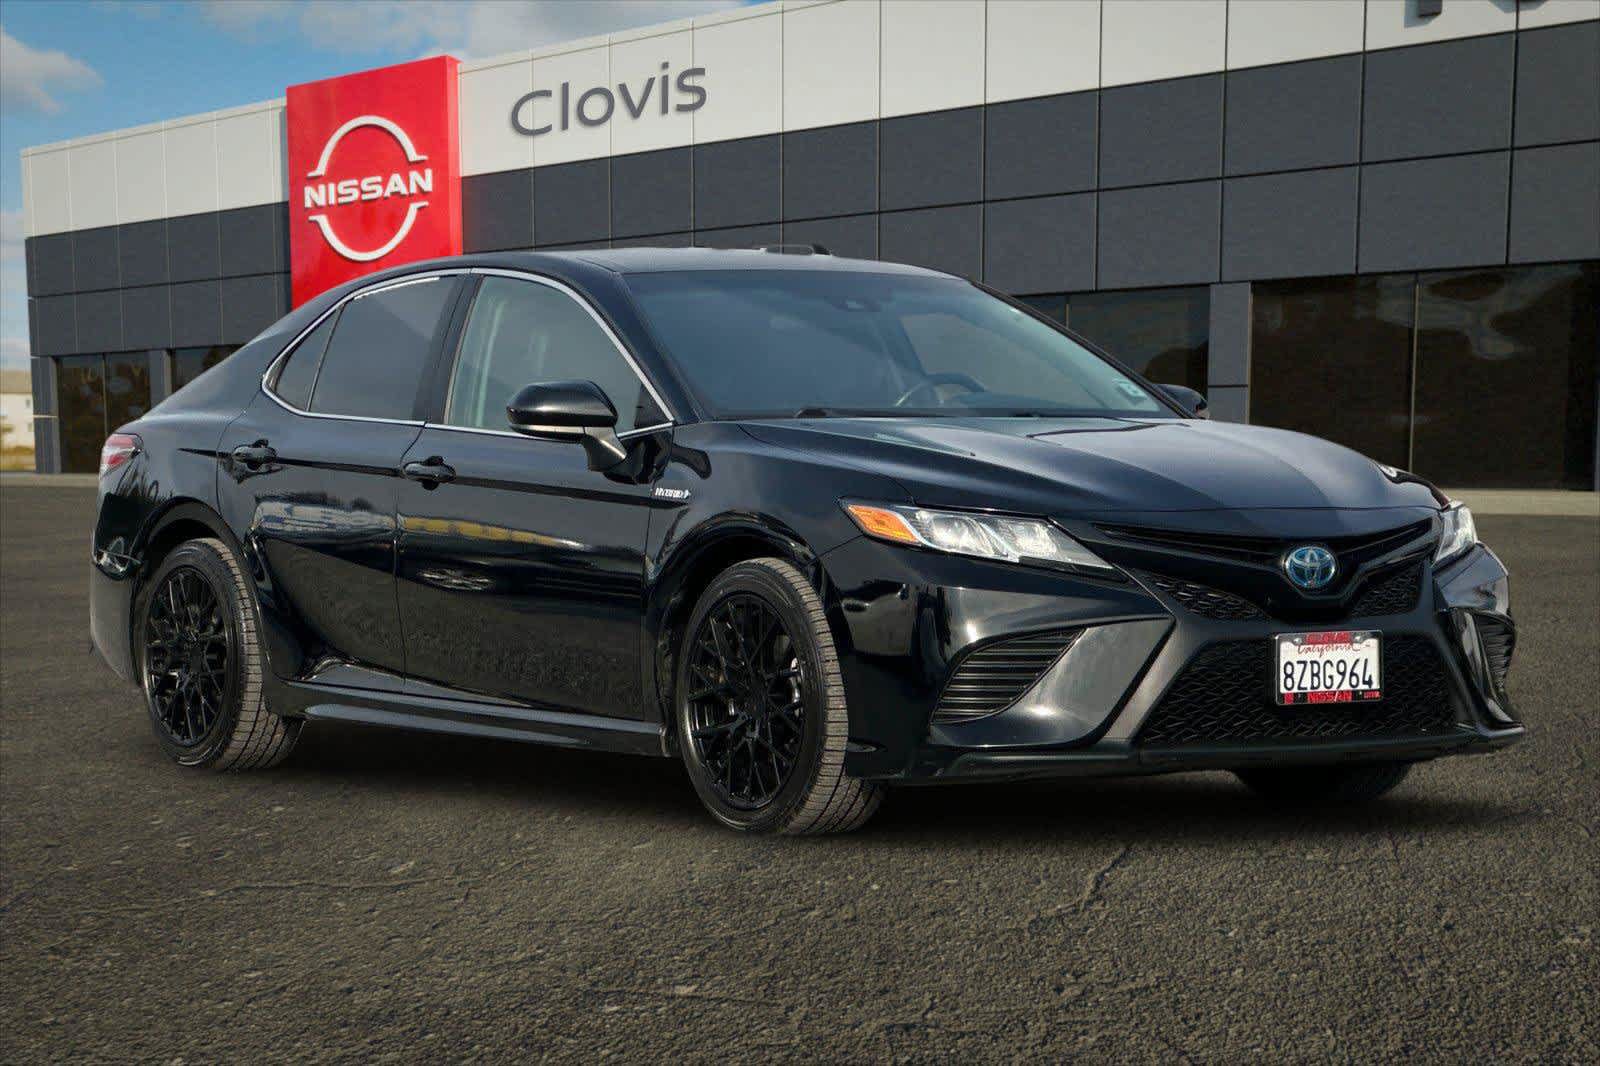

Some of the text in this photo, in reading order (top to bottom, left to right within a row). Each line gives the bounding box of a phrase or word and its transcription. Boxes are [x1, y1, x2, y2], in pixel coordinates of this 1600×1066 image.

[510, 62, 707, 136] Clovis
[304, 168, 433, 208] NISSAN
[1283, 658, 1373, 691] 8ZBG964
